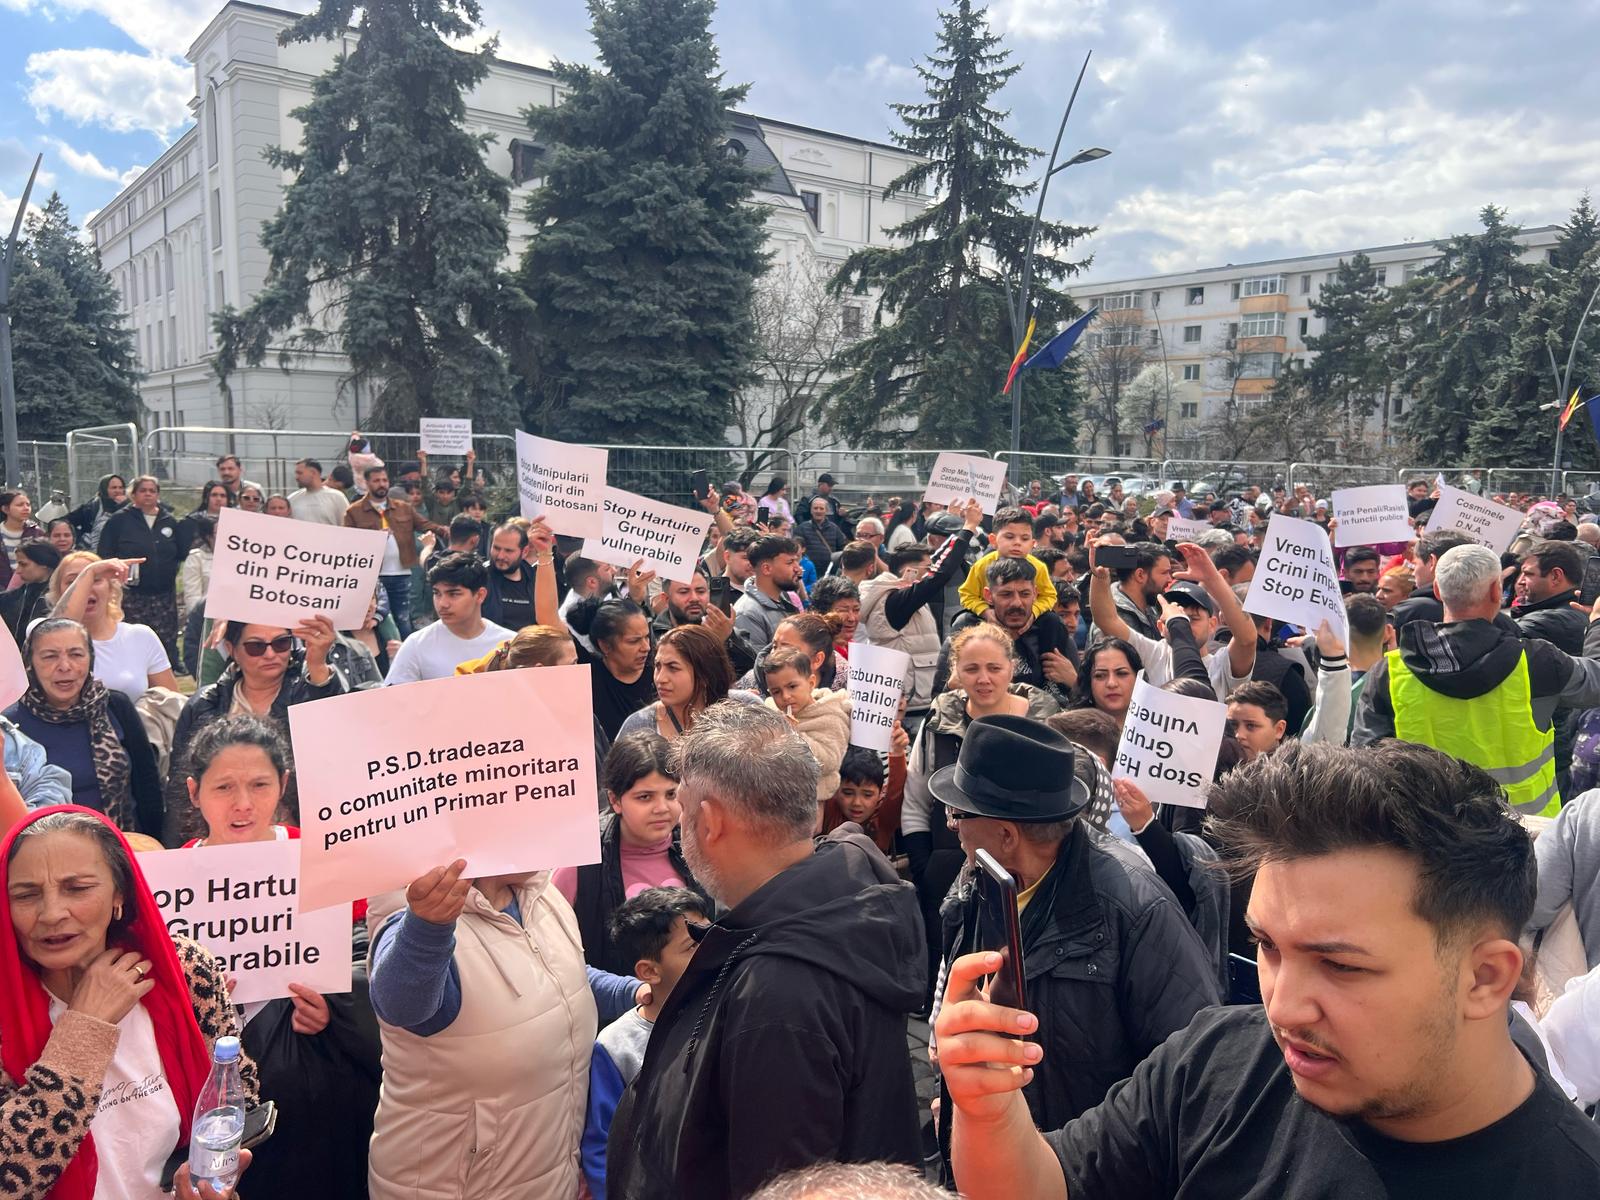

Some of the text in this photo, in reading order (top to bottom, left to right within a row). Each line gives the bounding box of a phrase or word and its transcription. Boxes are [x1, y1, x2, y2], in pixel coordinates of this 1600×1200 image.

[533, 464, 589, 483] Manipularii
[941, 466, 956, 475] Stop
[566, 486, 585, 497] din
[931, 481, 963, 491] Municipiul
[545, 495, 598, 512] Botosani
[1456, 498, 1505, 521] Cosminele
[604, 500, 701, 535] Stop Hartuire
[1459, 511, 1491, 527] nu uita
[618, 520, 676, 545] Grupuri
[227, 535, 375, 570] Stop Coruptiei
[601, 537, 682, 565] vulnerabile
[1276, 537, 1315, 560] Vrem
[236, 560, 358, 589] din Primaria
[1266, 558, 1308, 579] Crini
[250, 584, 341, 610] Botosani
[1262, 578, 1304, 601] Stop
[367, 739, 525, 780] P.S.D.tradeaza
[1149, 762, 1202, 788] Stop
[318, 758, 579, 821] o comunitate minoritara
[324, 780, 576, 850] pentru un Primar Penal
[153, 874, 296, 912] op Hartu
[214, 942, 320, 972] erabile
[121, 1096, 131, 1104] ON
[134, 1090, 149, 1100] THE
